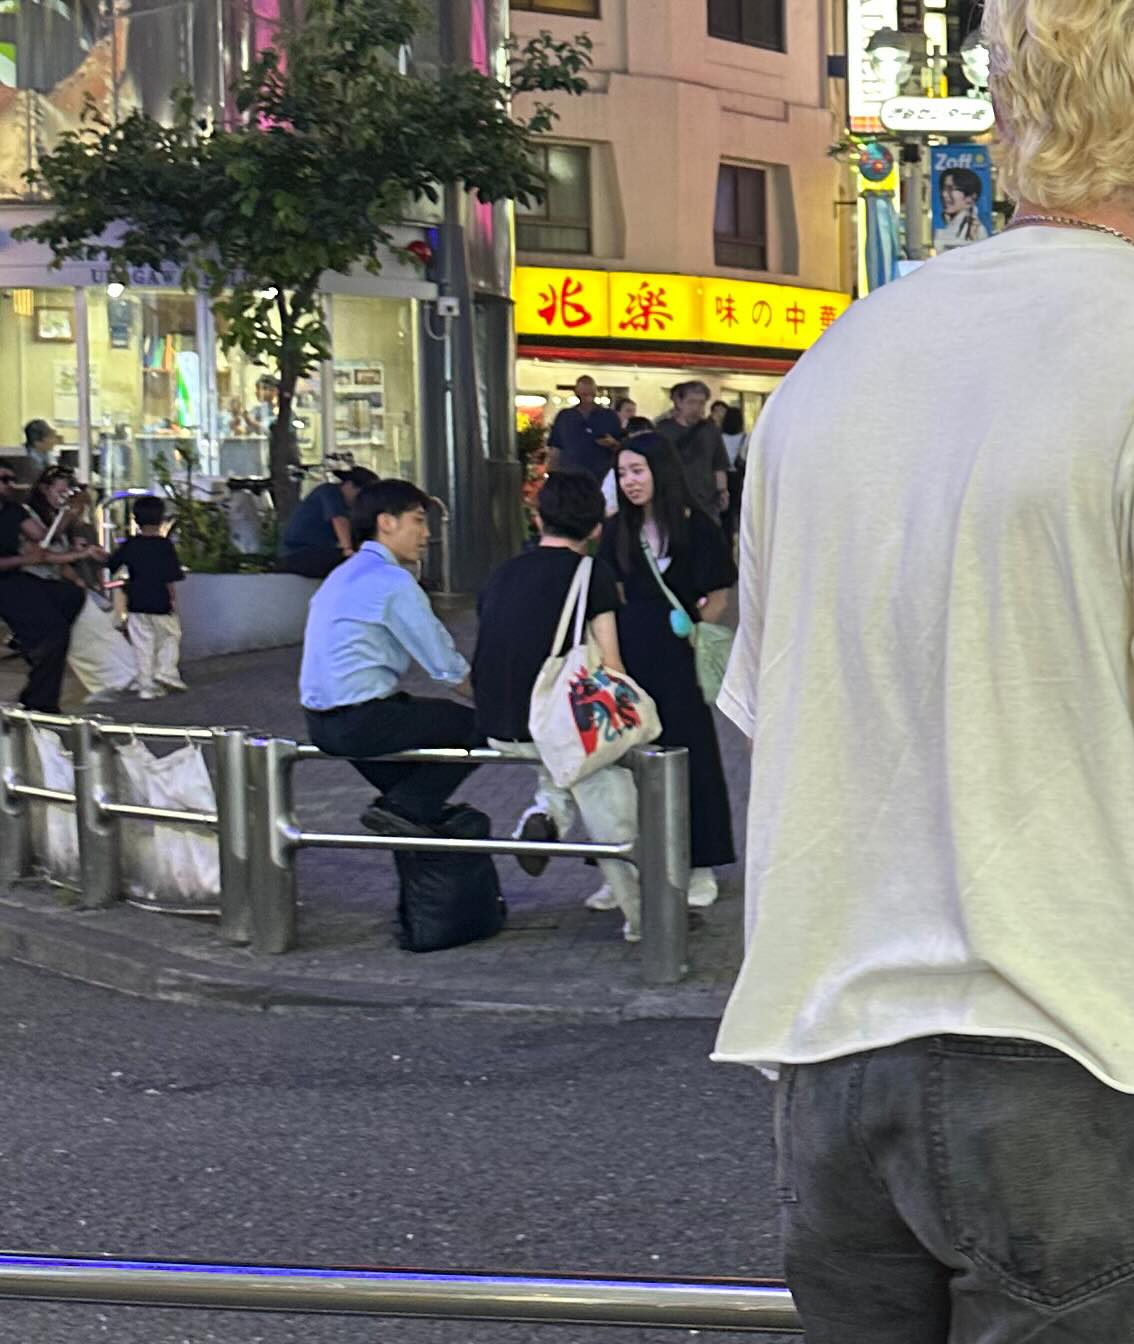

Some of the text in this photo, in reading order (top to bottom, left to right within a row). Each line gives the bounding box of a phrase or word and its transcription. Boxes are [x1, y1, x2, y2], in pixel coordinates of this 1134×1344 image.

[934, 153, 973, 171] Zoff
[537, 275, 838, 335] 兆楽 味の中華
